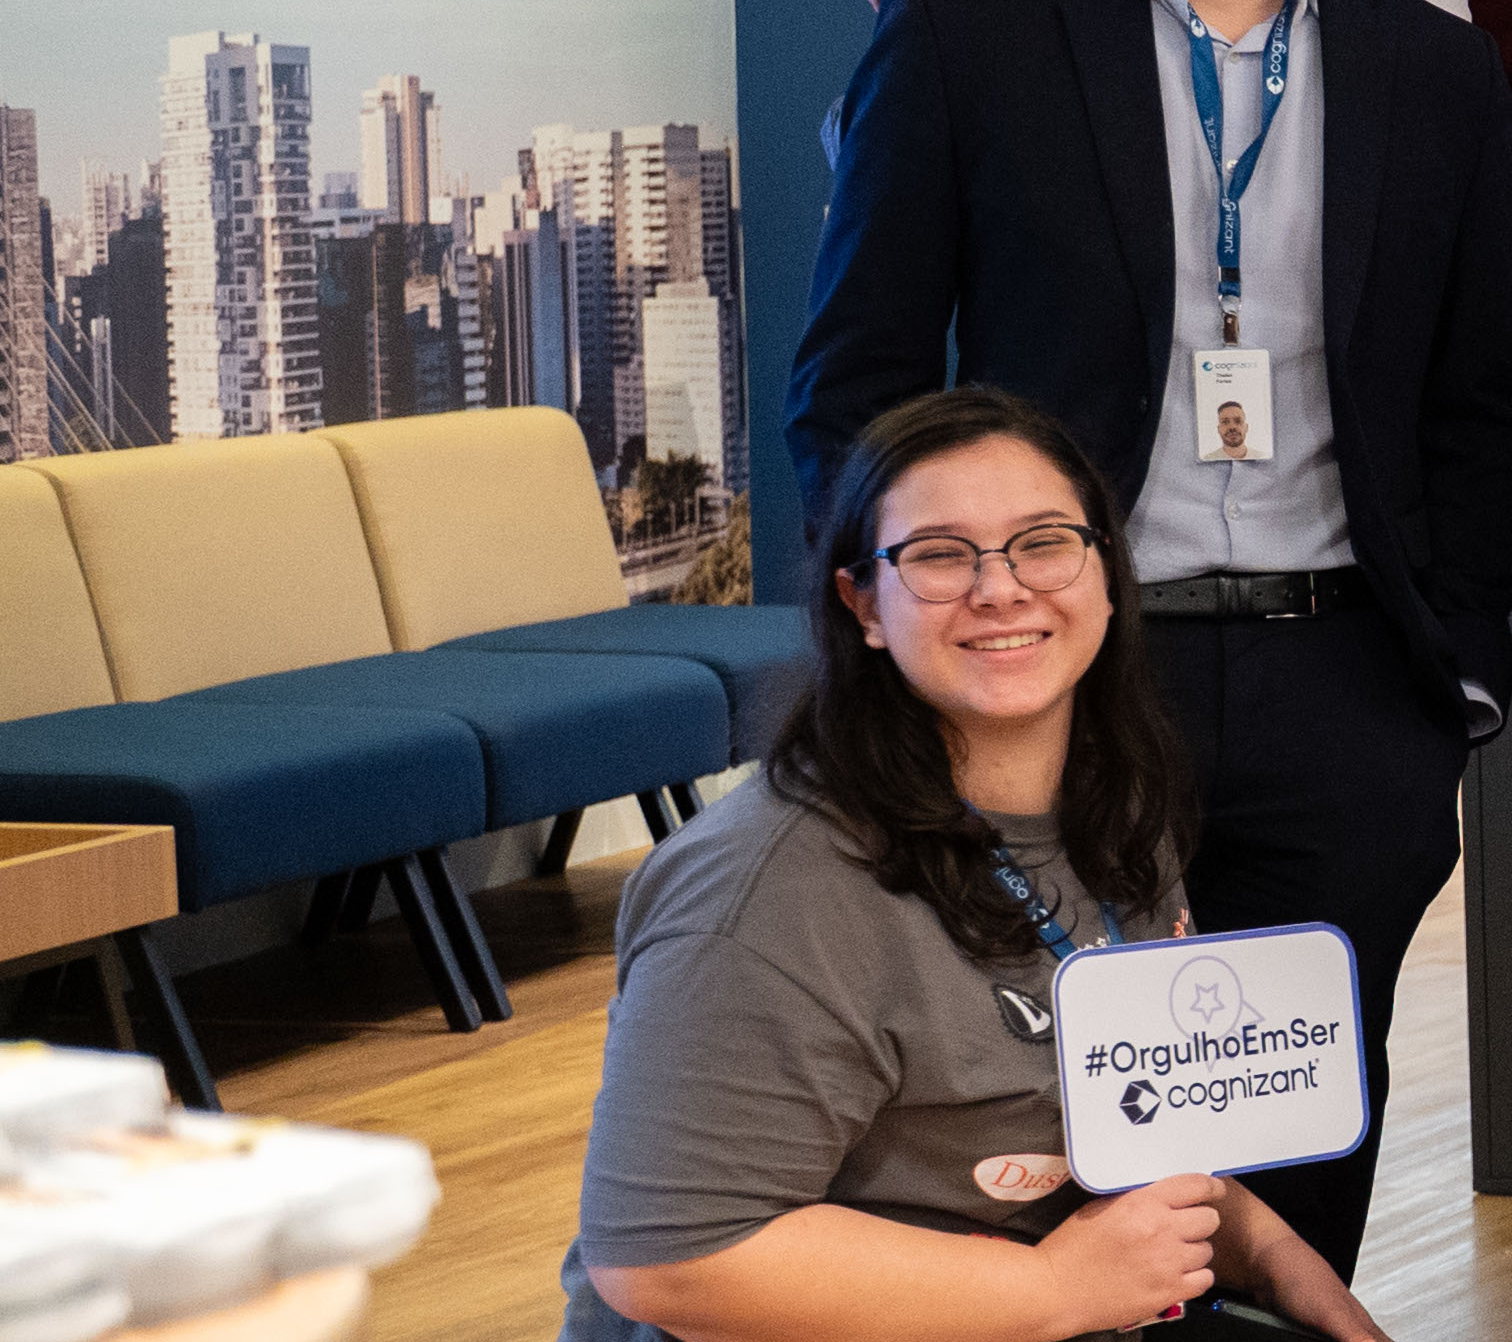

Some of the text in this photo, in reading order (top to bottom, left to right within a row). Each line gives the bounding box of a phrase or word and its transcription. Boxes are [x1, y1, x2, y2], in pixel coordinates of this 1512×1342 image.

[1222, 194, 1237, 255] gnizant
[1084, 1017, 1341, 1078] #OrgulhoEmSer
[1167, 1060, 1318, 1113] cognizant
